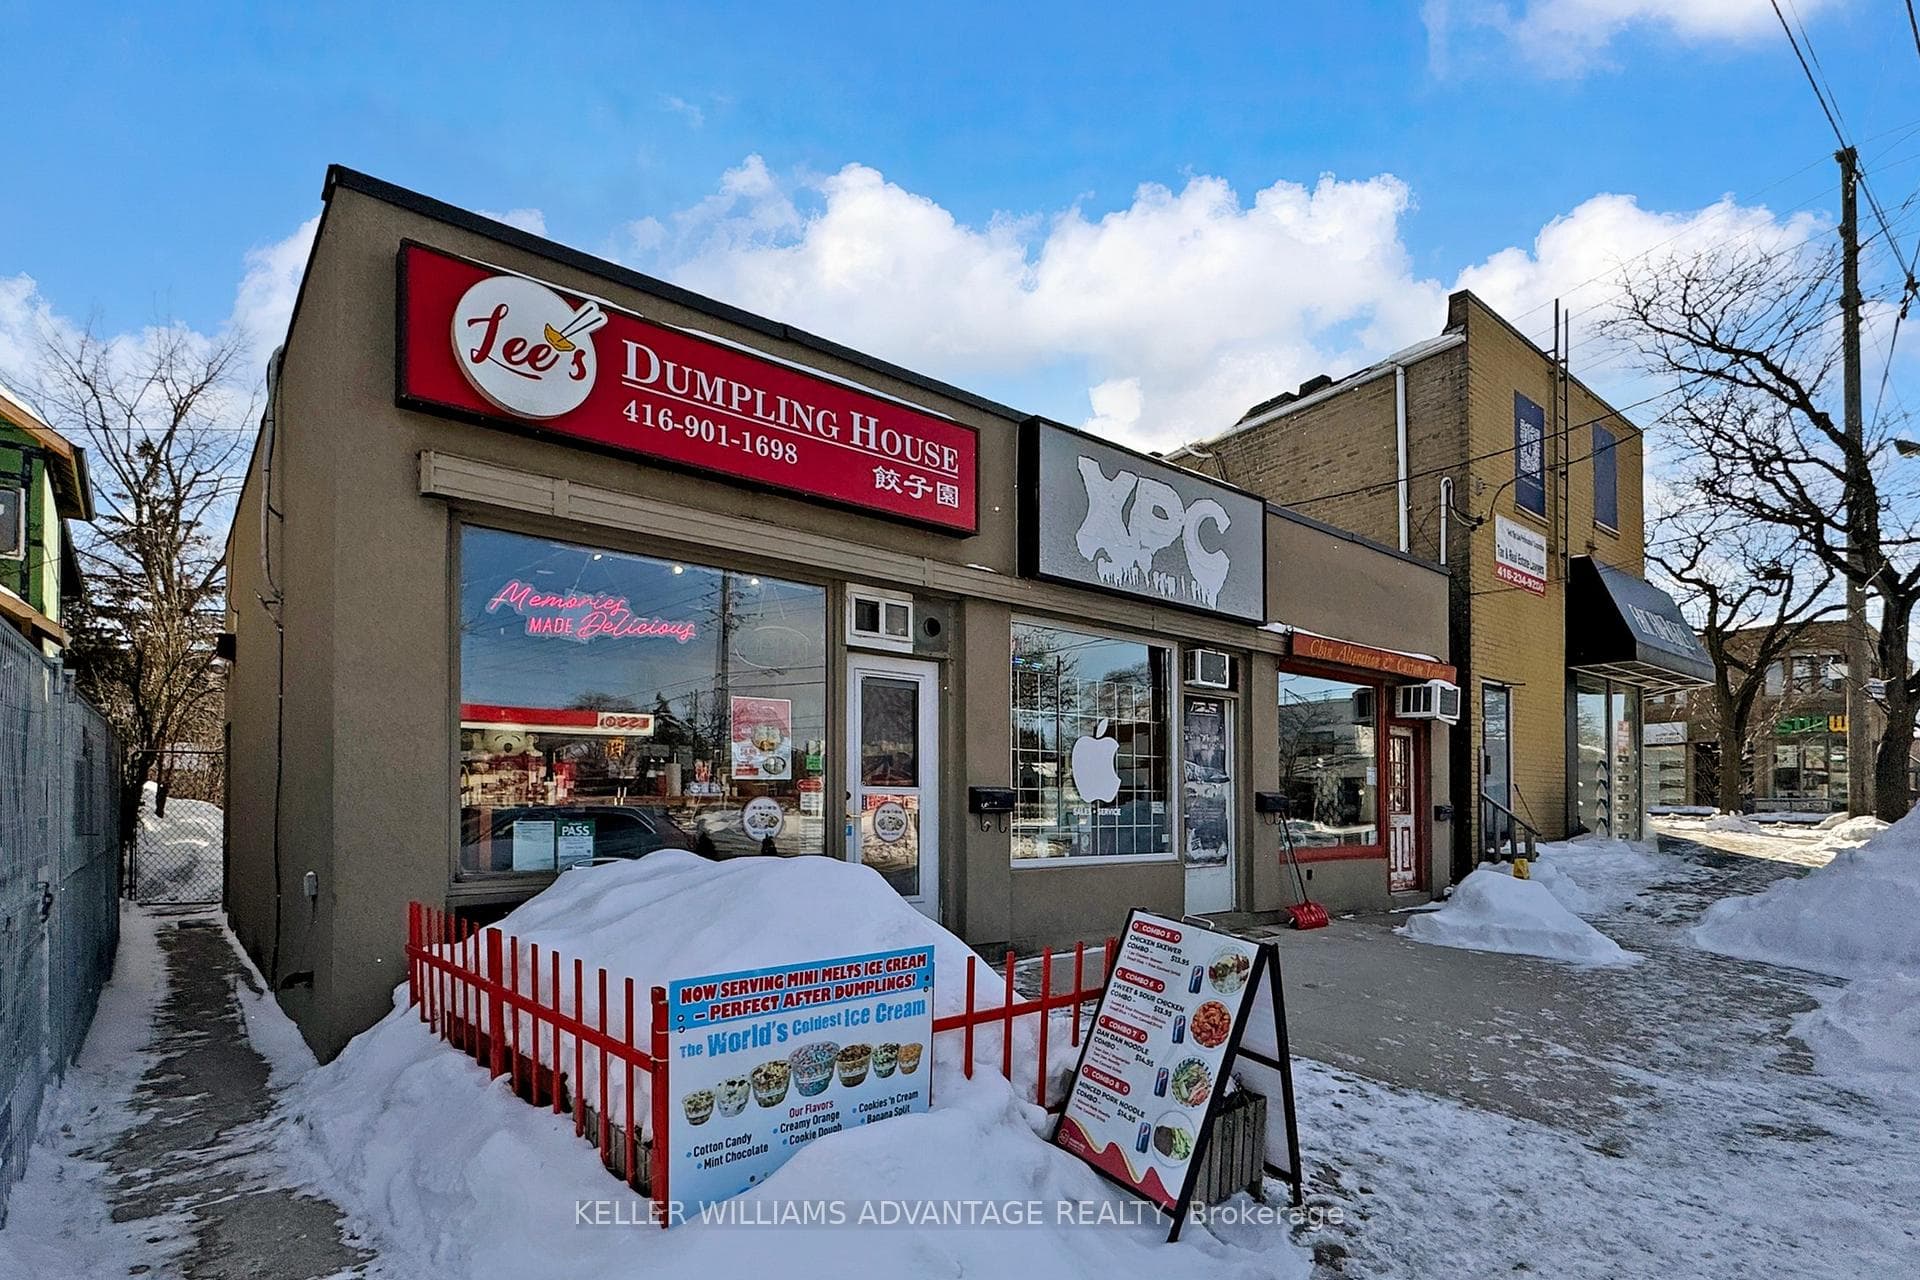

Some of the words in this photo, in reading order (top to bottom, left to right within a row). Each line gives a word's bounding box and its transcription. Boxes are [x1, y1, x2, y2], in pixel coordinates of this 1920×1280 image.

[467, 303, 587, 382] Lee's
[622, 399, 799, 465] 416-901-1698
[850, 410, 960, 474] HOUSE
[872, 465, 960, 509] 餃子園
[491, 581, 628, 612] Memories
[529, 616, 573, 634] MADE
[576, 611, 696, 641] Delicious
[562, 825, 590, 836] PASS
[1141, 924, 1166, 937] COMBO
[1126, 941, 1150, 954] COMBO
[1128, 933, 1155, 947] CHICKEN
[1154, 942, 1182, 955] SKEWER
[680, 983, 717, 1005] NOW
[720, 974, 784, 997] SERVING
[787, 970, 818, 988] MINI
[822, 964, 861, 983] MELTS
[864, 962, 882, 976] ICE
[885, 953, 927, 972] CREAM
[1124, 971, 1148, 985] COMBO
[710, 997, 780, 1020] PERFECT
[783, 989, 831, 1008] AFTER
[835, 973, 916, 1000] DUMPLINGS!
[1109, 988, 1132, 1002] COMBO
[1112, 981, 1133, 994] SWEET
[1133, 988, 1139, 996] &
[1138, 990, 1156, 1002] SOUR
[1155, 997, 1185, 1013] CHICKEN
[680, 1045, 703, 1058] The
[707, 1021, 788, 1057] World's
[792, 1012, 842, 1036] Coldest
[845, 1008, 870, 1027] Ice
[875, 999, 926, 1024] Cream
[1108, 1020, 1131, 1035] COMBO
[1093, 1035, 1116, 1050] COMBO
[1095, 1027, 1110, 1038] DAN
[1109, 1033, 1123, 1044] DAN
[1122, 1039, 1149, 1055] NOODLE
[1090, 1070, 1114, 1086] COMBO
[859, 1098, 887, 1113] Cookies
[896, 1090, 919, 1103] Cream
[1075, 1087, 1098, 1104] COMBO
[1078, 1079, 1102, 1096] MINCED
[1101, 1090, 1119, 1105] PORK
[1118, 1099, 1145, 1118] NOODLE
[789, 1107, 803, 1118] Our
[805, 1100, 834, 1116] Flavors
[866, 1110, 893, 1124] Banana
[894, 1104, 911, 1117] Split
[780, 1117, 810, 1134] Creamy
[813, 1110, 840, 1128] Orange
[693, 1139, 723, 1158] Cotton
[725, 1133, 752, 1151] Candy
[789, 1130, 816, 1145] Cookie
[704, 1154, 723, 1170] Mint
[725, 1143, 769, 1164] Chocolate
